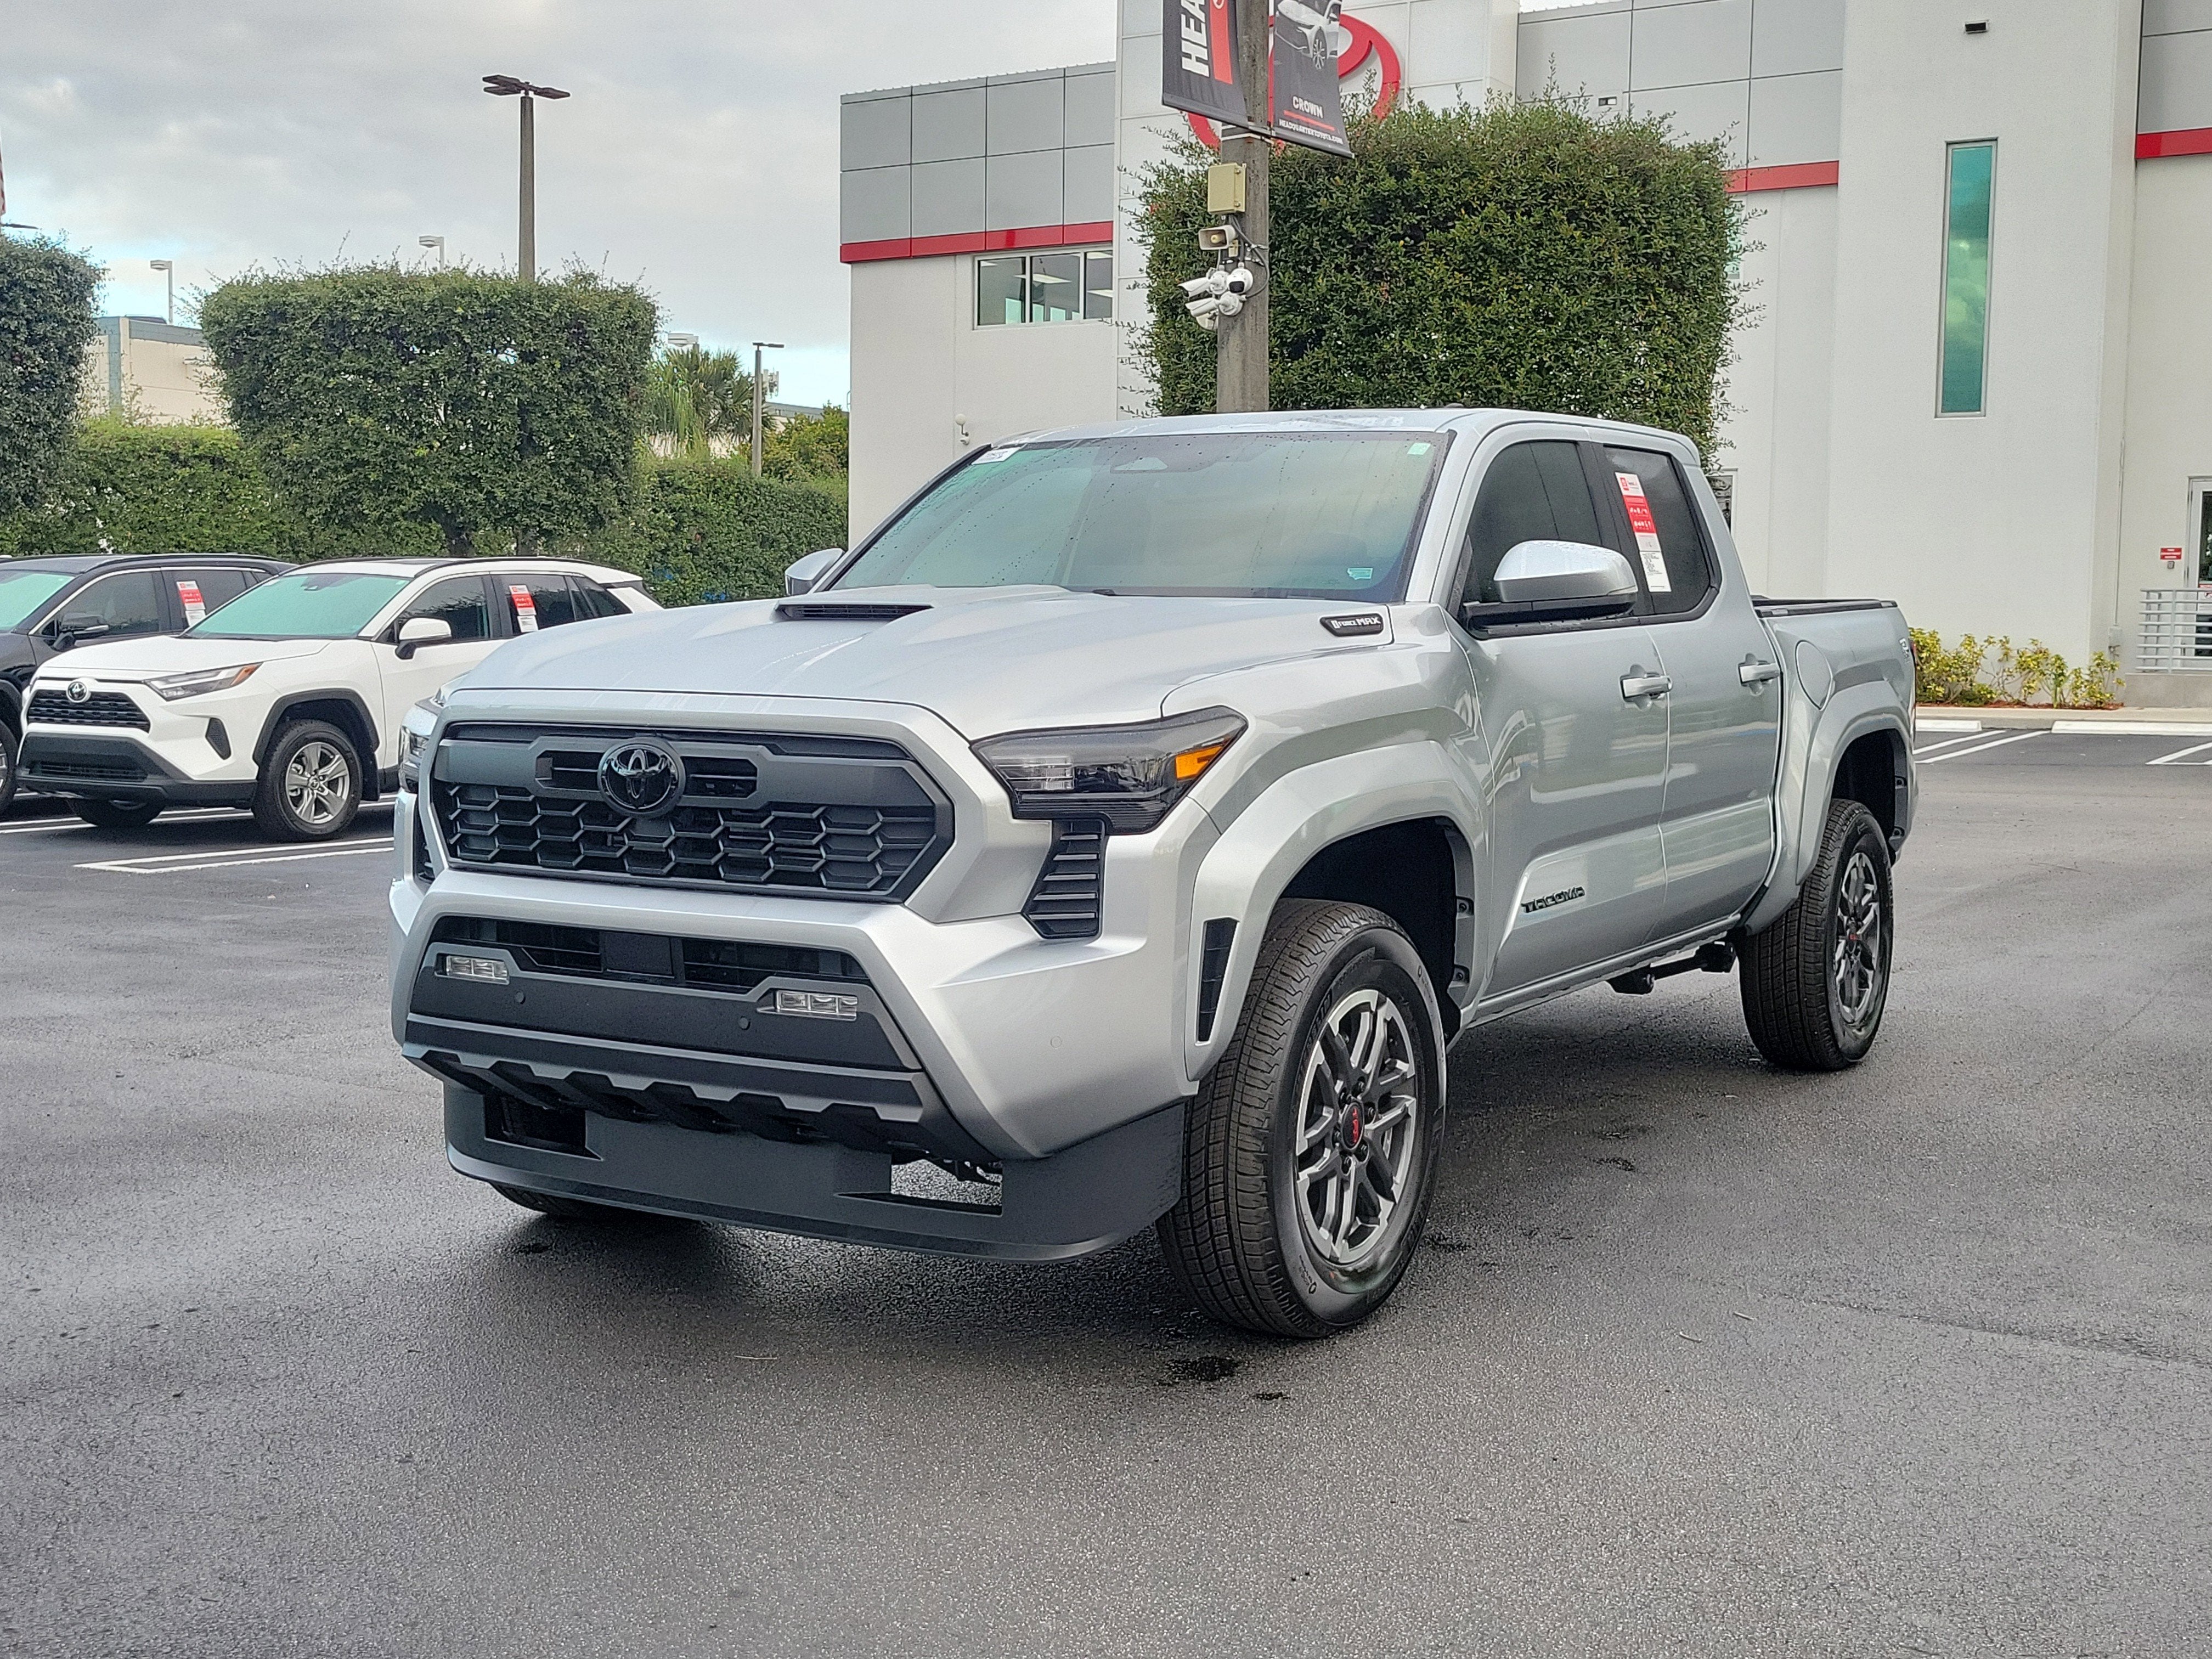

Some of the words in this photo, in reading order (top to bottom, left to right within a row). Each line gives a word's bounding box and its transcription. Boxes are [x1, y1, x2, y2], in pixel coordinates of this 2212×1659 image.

[1292, 95, 1324, 119] CROWN
[1356, 617, 1381, 625] MAX
[1521, 886, 1585, 913] TACOMA
